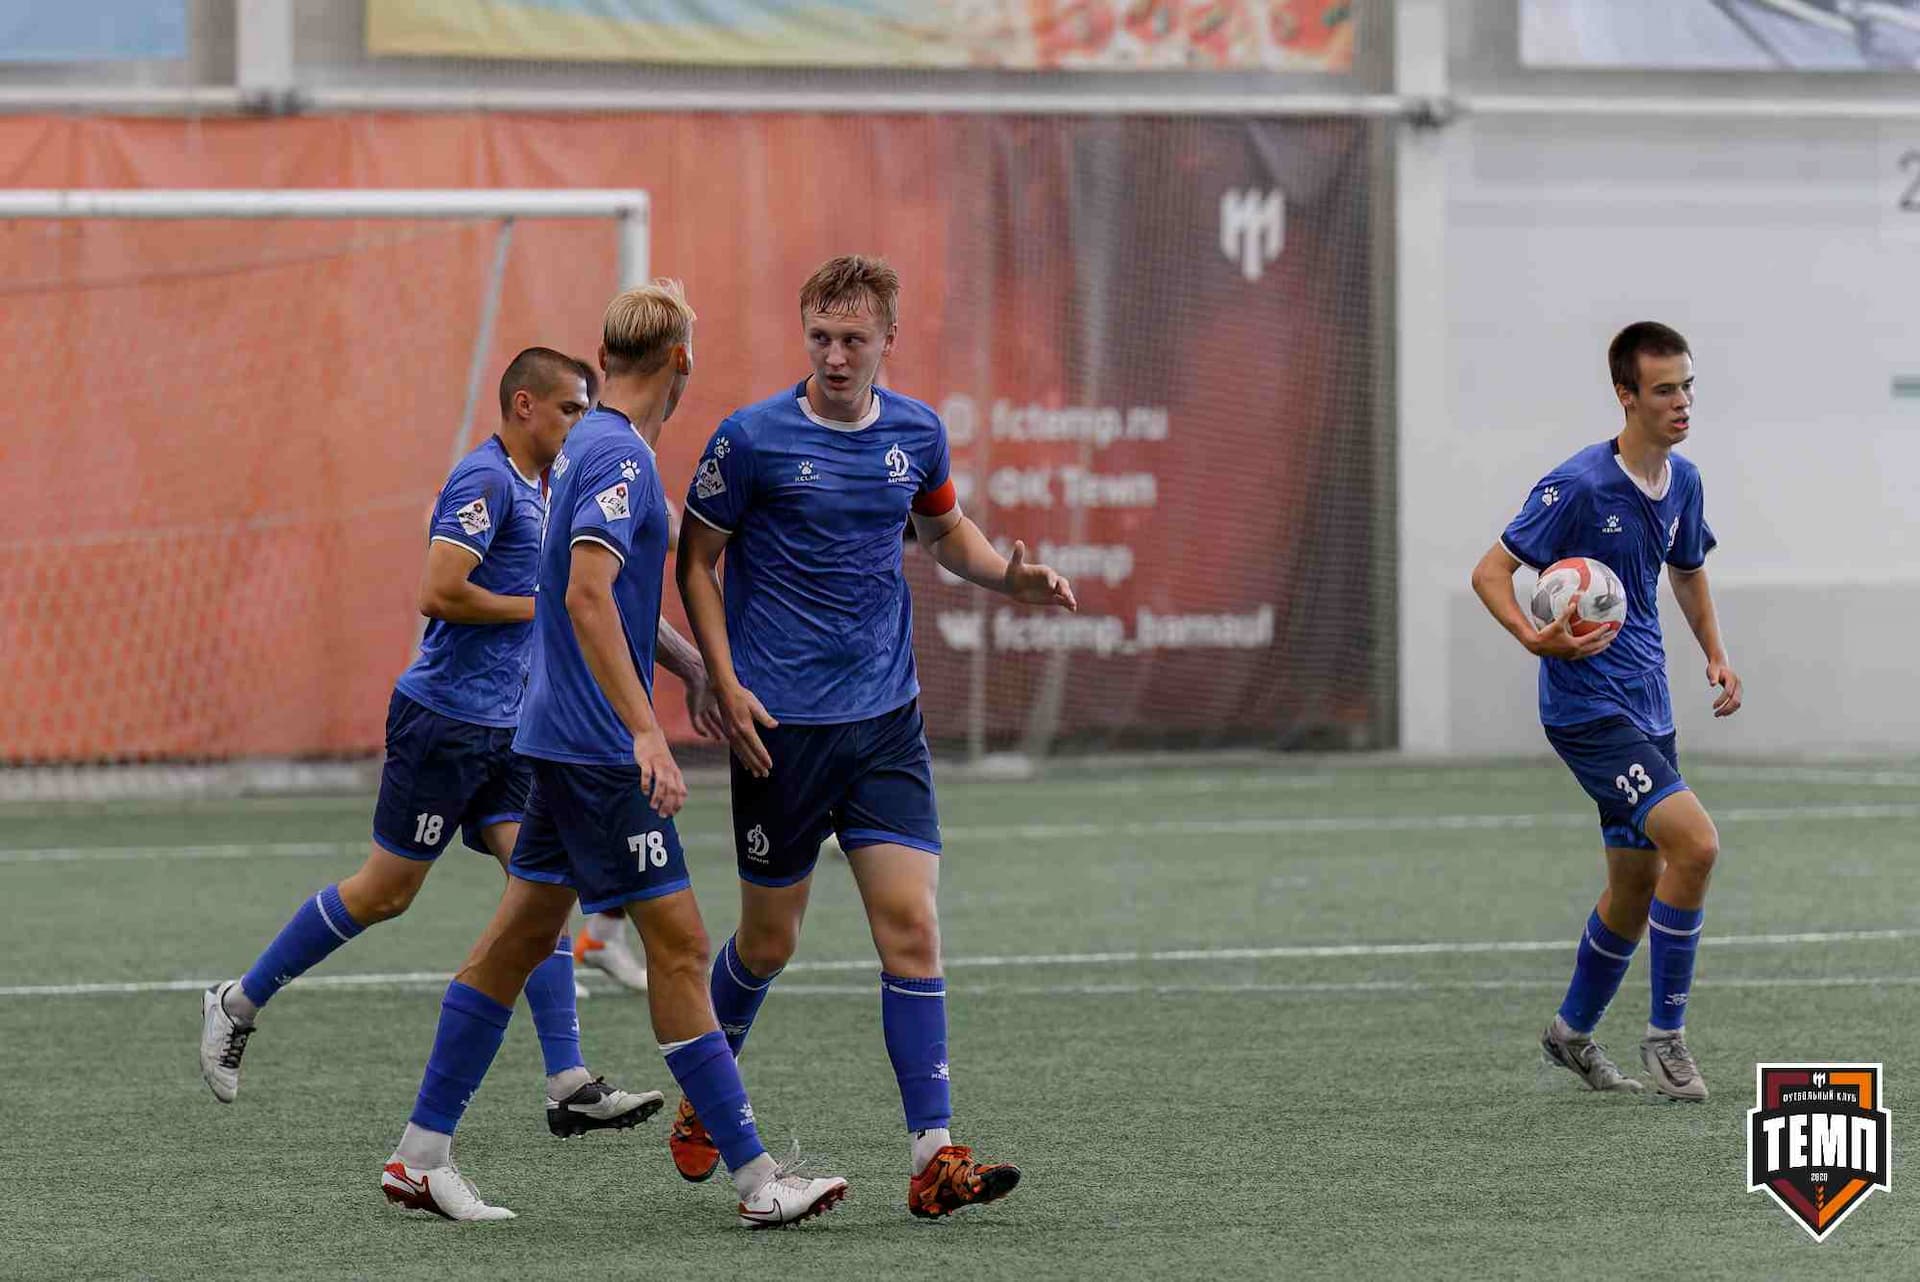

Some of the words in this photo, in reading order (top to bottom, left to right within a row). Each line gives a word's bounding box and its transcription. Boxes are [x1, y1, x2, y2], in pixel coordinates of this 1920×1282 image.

[989, 401, 1168, 447] fctemp.ru
[992, 603, 1275, 657] fctemp_barnaul
[1615, 763, 1653, 805] 33
[414, 812, 444, 846] 18
[627, 830, 669, 873] 78
